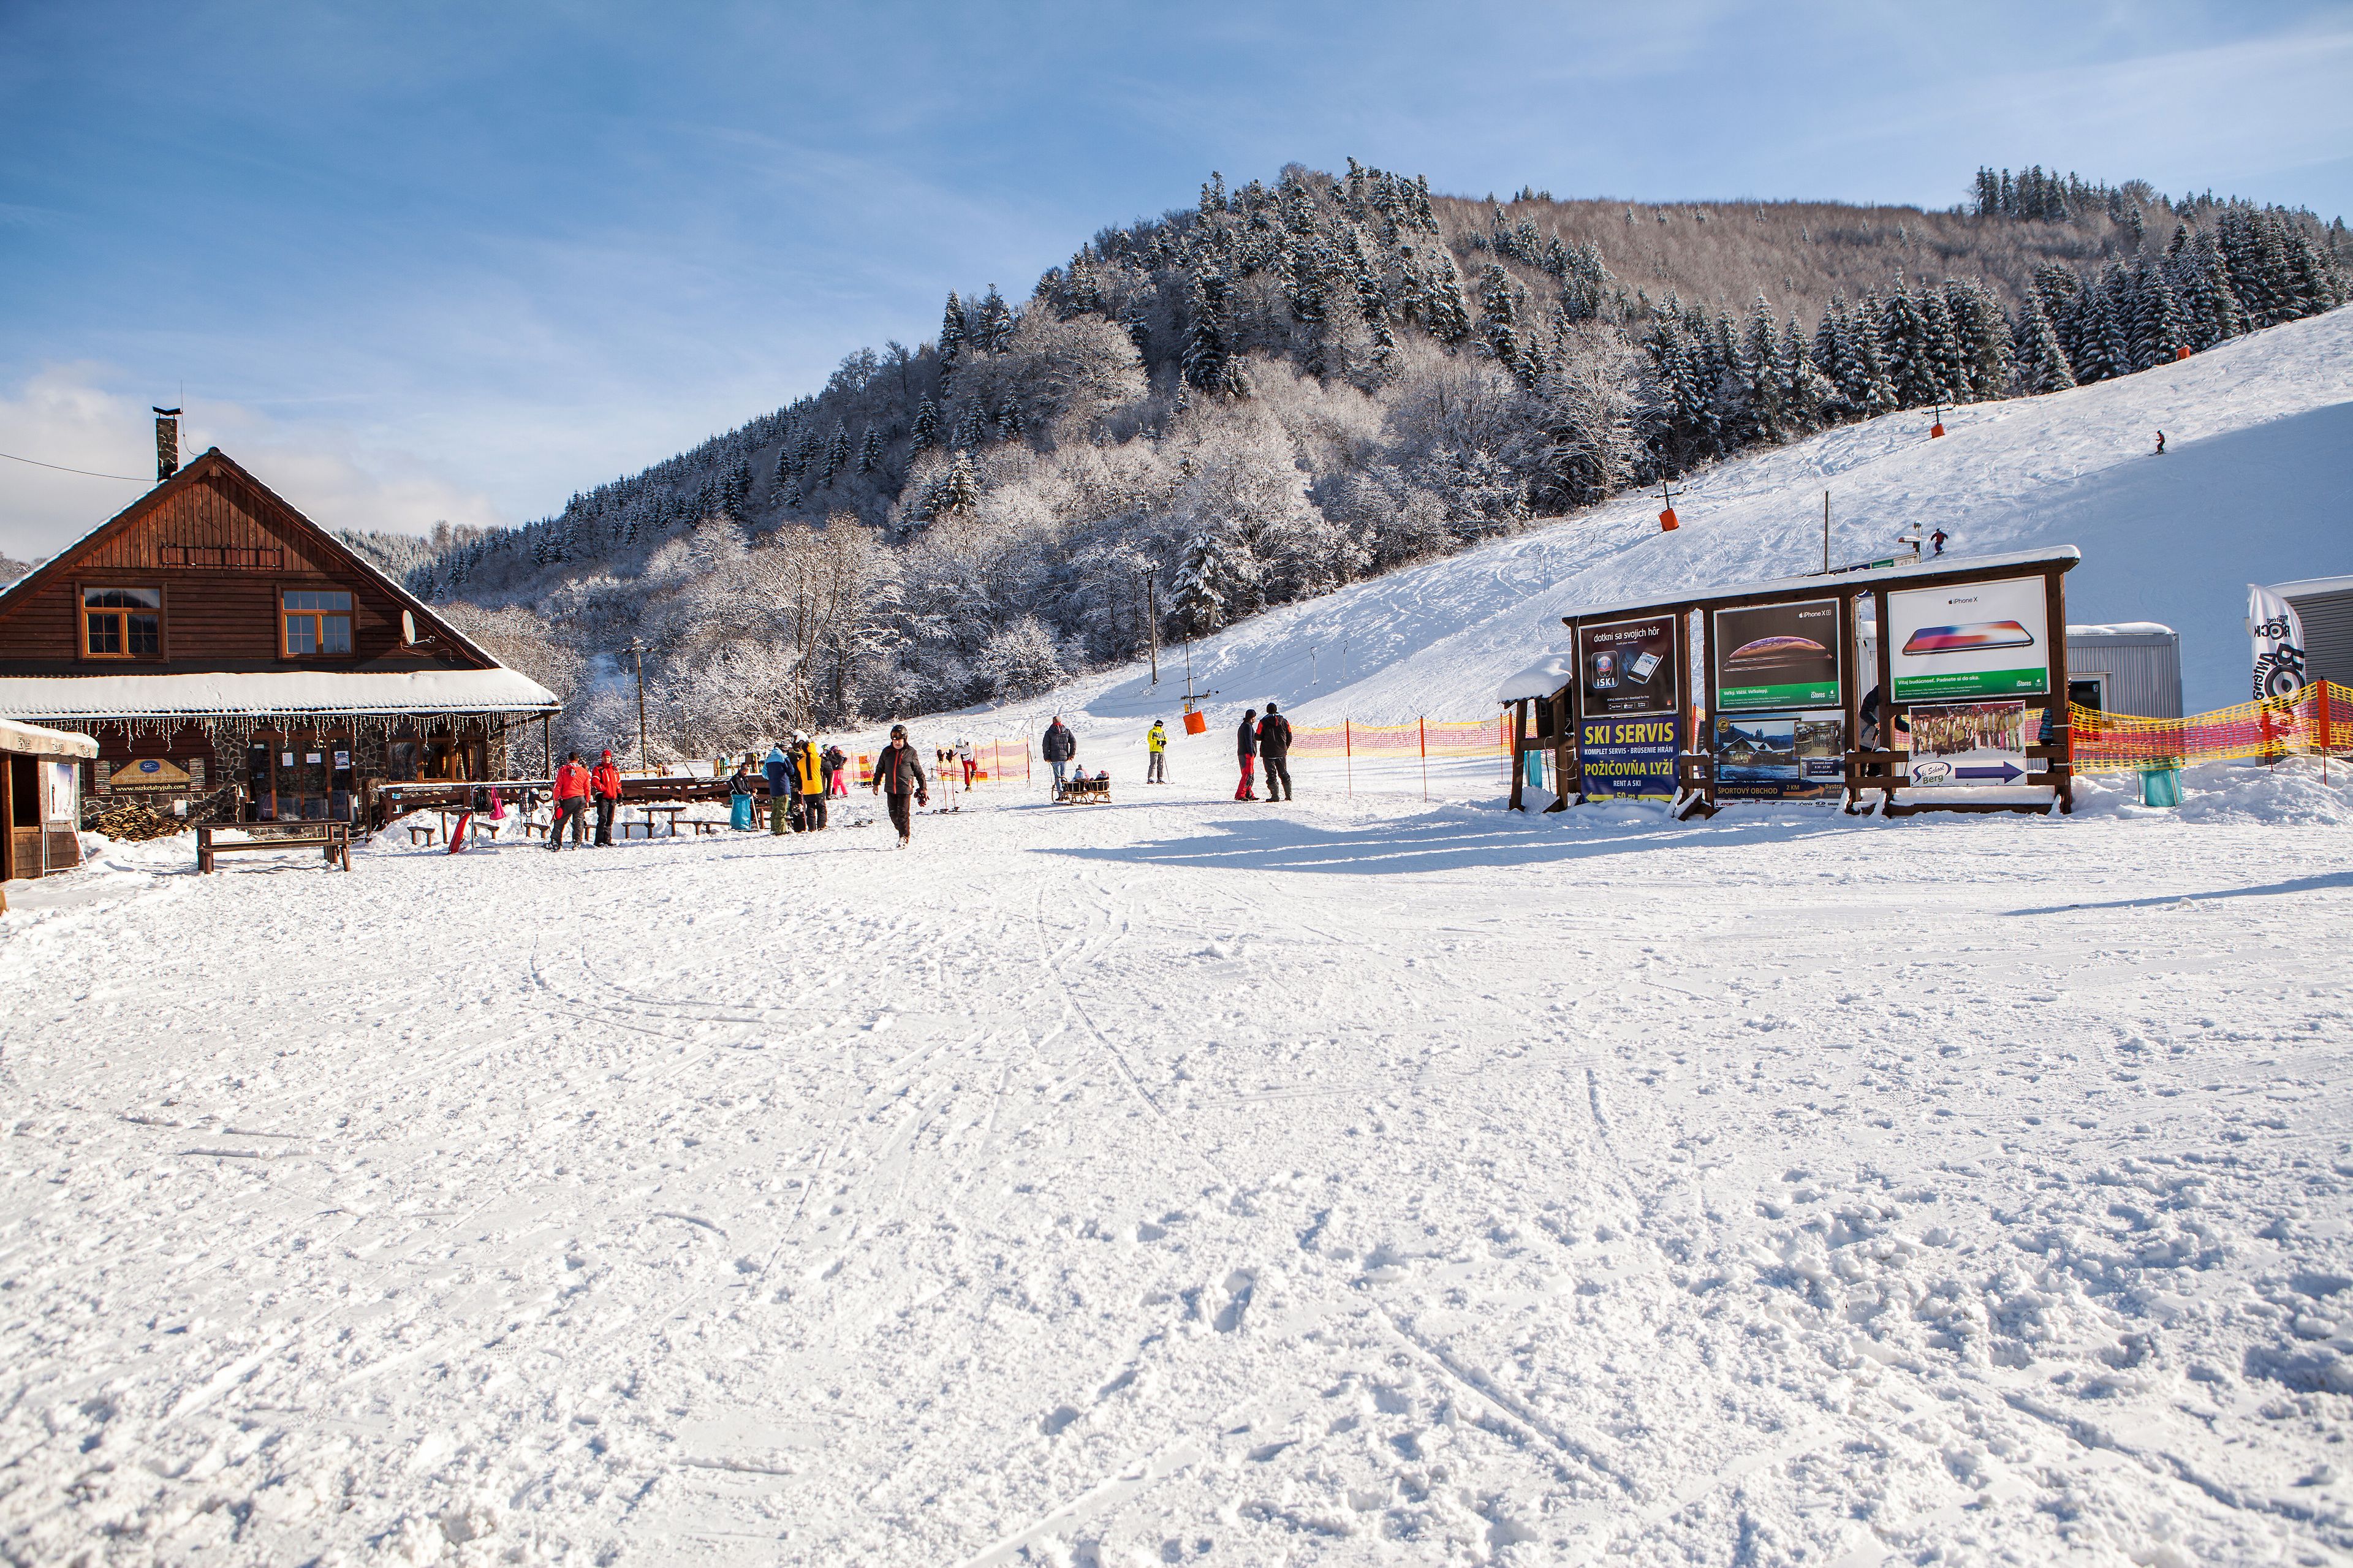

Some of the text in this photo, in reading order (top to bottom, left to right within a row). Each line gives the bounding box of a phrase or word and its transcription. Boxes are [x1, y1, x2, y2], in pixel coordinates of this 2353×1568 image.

[1594, 632, 1613, 643] dotkni
[1624, 628, 1646, 639] svojich
[1648, 626, 1660, 636] hôr
[1596, 678, 1615, 687] iSKI
[1585, 722, 1674, 745] SKI SERVIS
[1657, 744, 1673, 753] HRÁN
[1585, 759, 1673, 776] POŽIČOVŇA LYŽÍ
[1928, 765, 1945, 775] School
[1923, 775, 1944, 784] Berg
[115, 784, 186, 792] www.nizketatryjuh.com
